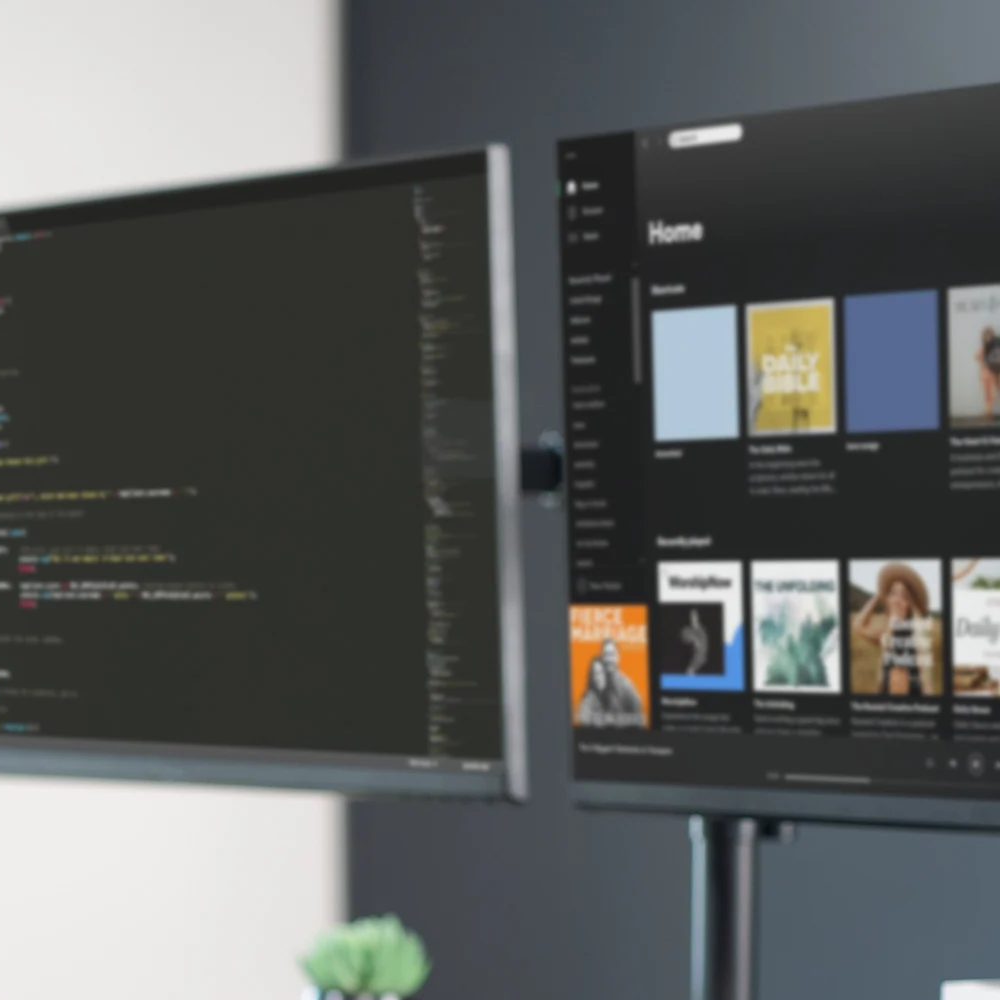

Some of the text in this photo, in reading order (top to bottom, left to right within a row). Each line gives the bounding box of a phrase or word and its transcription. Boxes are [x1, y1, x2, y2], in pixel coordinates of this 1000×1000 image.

[648, 220, 704, 245] Home
[761, 351, 819, 373] DAILY
[761, 372, 821, 394] BIBLE
